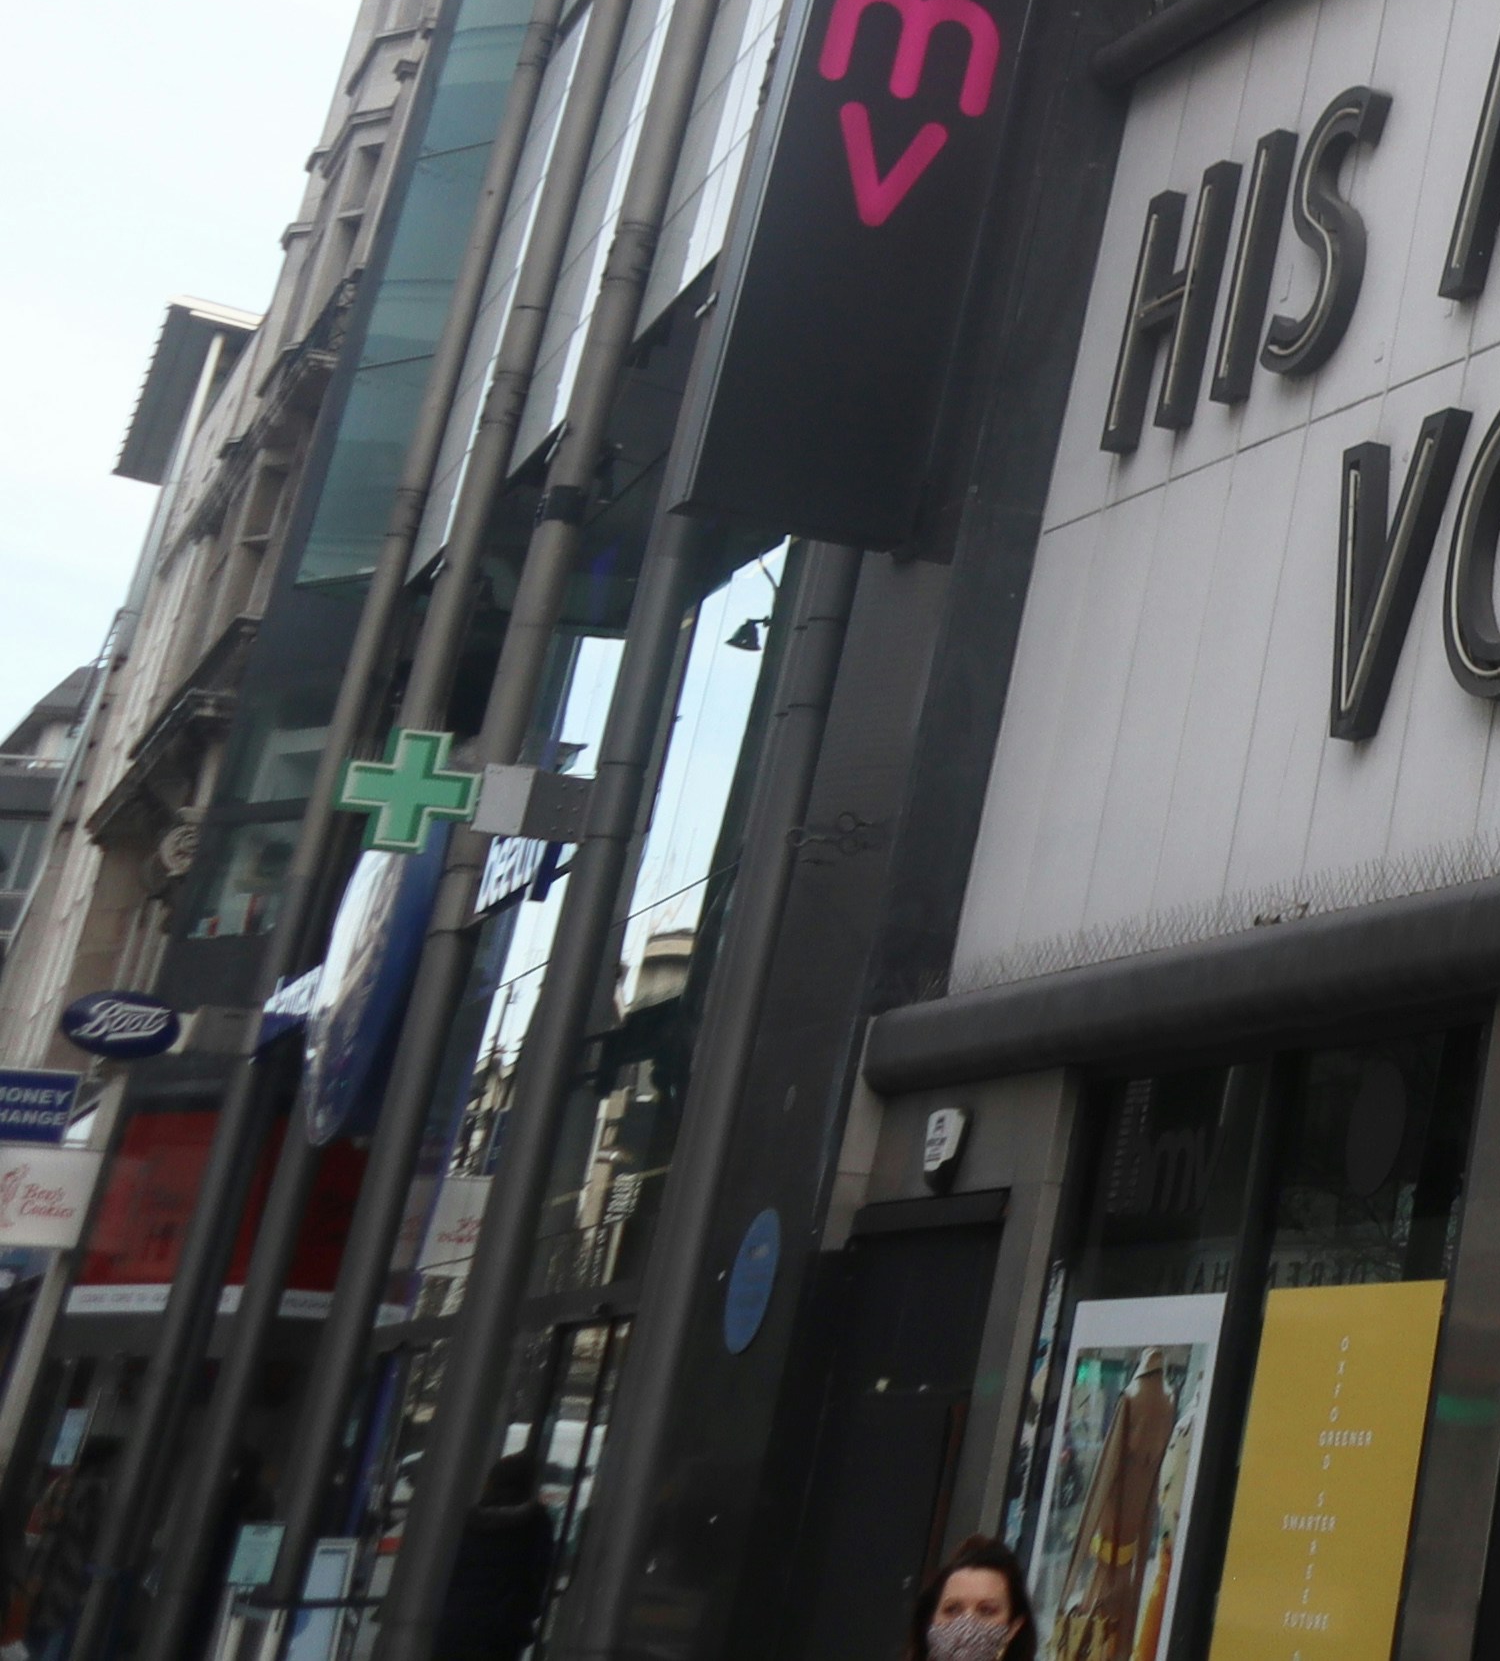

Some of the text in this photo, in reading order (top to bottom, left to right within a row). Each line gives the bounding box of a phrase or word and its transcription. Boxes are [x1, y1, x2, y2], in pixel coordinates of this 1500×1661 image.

[1101, 86, 1392, 454] HIS
[70, 999, 172, 1041] Boots
[1318, 1430, 1373, 1447] GREENER
[1281, 1514, 1337, 1532] SMARTER
